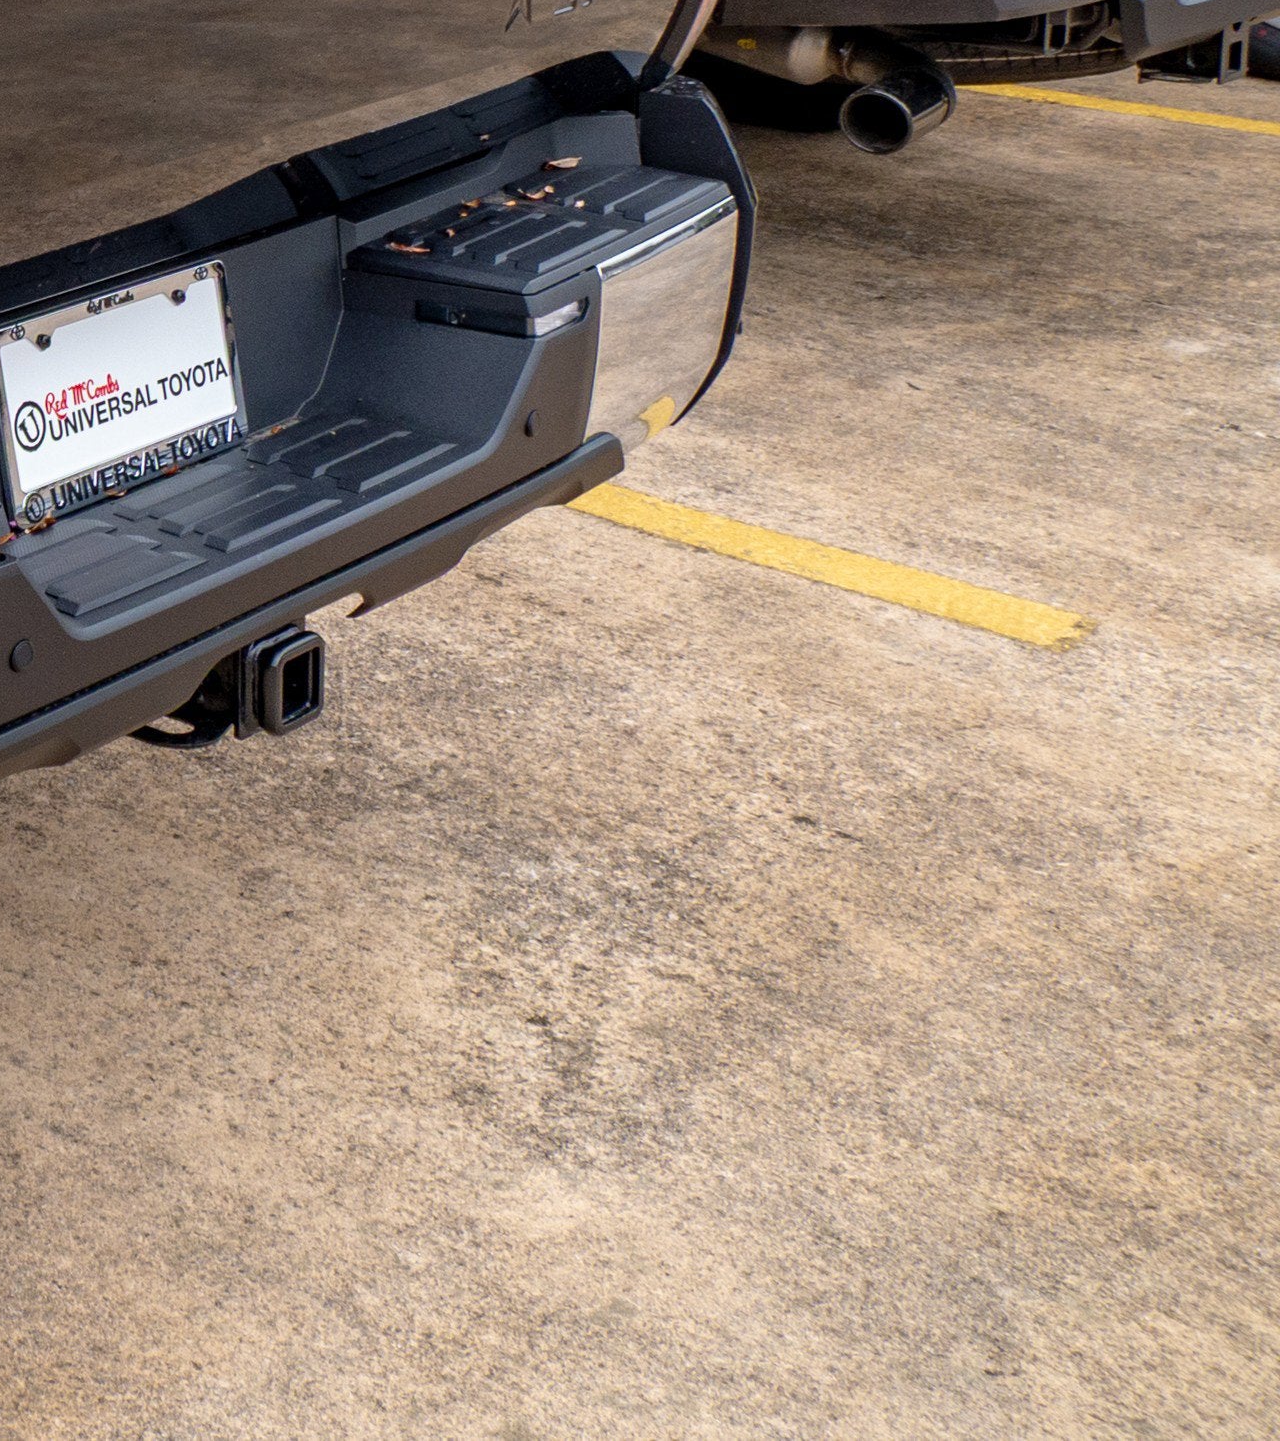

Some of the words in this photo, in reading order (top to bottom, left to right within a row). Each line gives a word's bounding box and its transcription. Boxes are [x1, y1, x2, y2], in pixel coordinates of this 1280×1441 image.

[45, 392, 68, 419] Red
[48, 385, 158, 441] UNIVERSAL
[157, 357, 229, 400] TOYOTA
[50, 446, 167, 509] UNIVERSAL
[167, 418, 243, 464] TOYOTA
